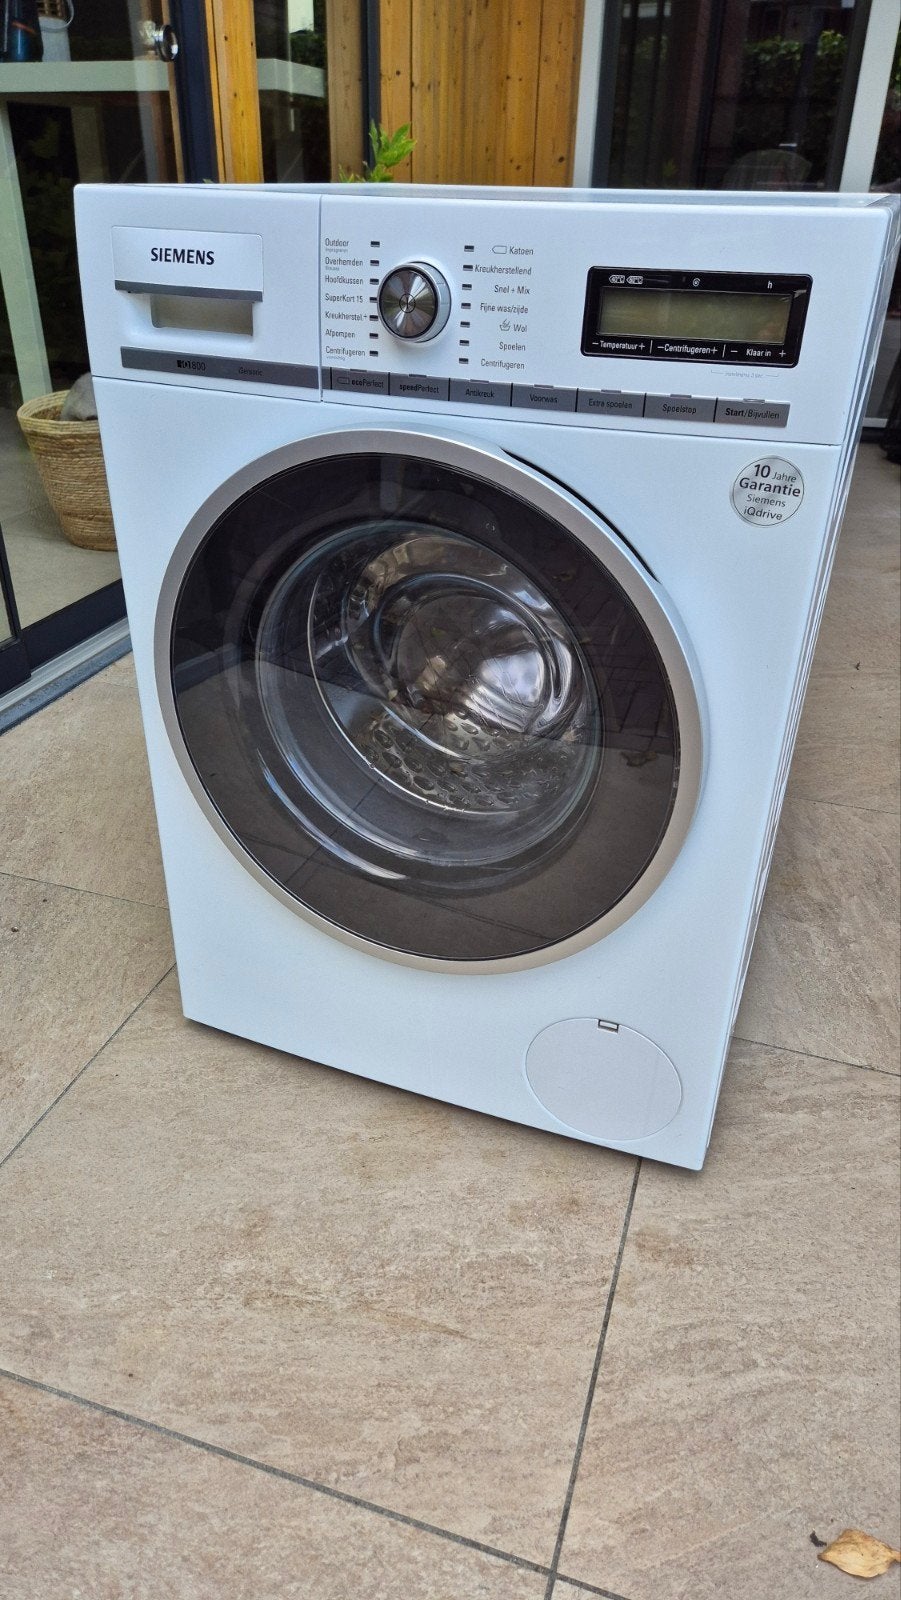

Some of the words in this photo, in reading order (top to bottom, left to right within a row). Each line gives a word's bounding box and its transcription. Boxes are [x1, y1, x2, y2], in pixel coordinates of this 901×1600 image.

[325, 238, 349, 247] Outdoor
[151, 247, 215, 265] SIEMENS
[509, 246, 534, 255] Katoen
[325, 256, 363, 266] Overhemden
[475, 264, 532, 275] Kreukherstellend
[325, 275, 364, 285] Hoofdkussen
[494, 284, 509, 293] Snel
[517, 285, 530, 294] Mix
[325, 293, 355, 302] SuperKort
[356, 295, 363, 303] 15
[480, 302, 495, 313] Fijne
[497, 304, 528, 315] was/zijde
[513, 323, 527, 332] Wol
[499, 341, 526, 351] Spoelen
[600, 340, 638, 350] Temperatuur
[664, 343, 711, 354] Centrifugeren
[326, 346, 366, 357] Centrifugeren
[746, 348, 763, 357] Klaar
[764, 349, 772, 357] in
[481, 358, 525, 370] Centrifugeren
[352, 379, 384, 388] ecoPerfect
[400, 384, 439, 393] speedPerfect
[465, 388, 495, 398] Antikreuk
[529, 393, 558, 404] Voorwas
[588, 398, 605, 408] Extra
[606, 400, 633, 410] spoelen
[662, 403, 697, 414] Spoelstop
[725, 407, 780, 420] Start/Bijvullen
[754, 464, 771, 478] 10
[772, 472, 797, 483] Jahre
[739, 477, 801, 497] Garantie
[746, 493, 786, 508] Siemens
[744, 506, 783, 521] iQdrive
